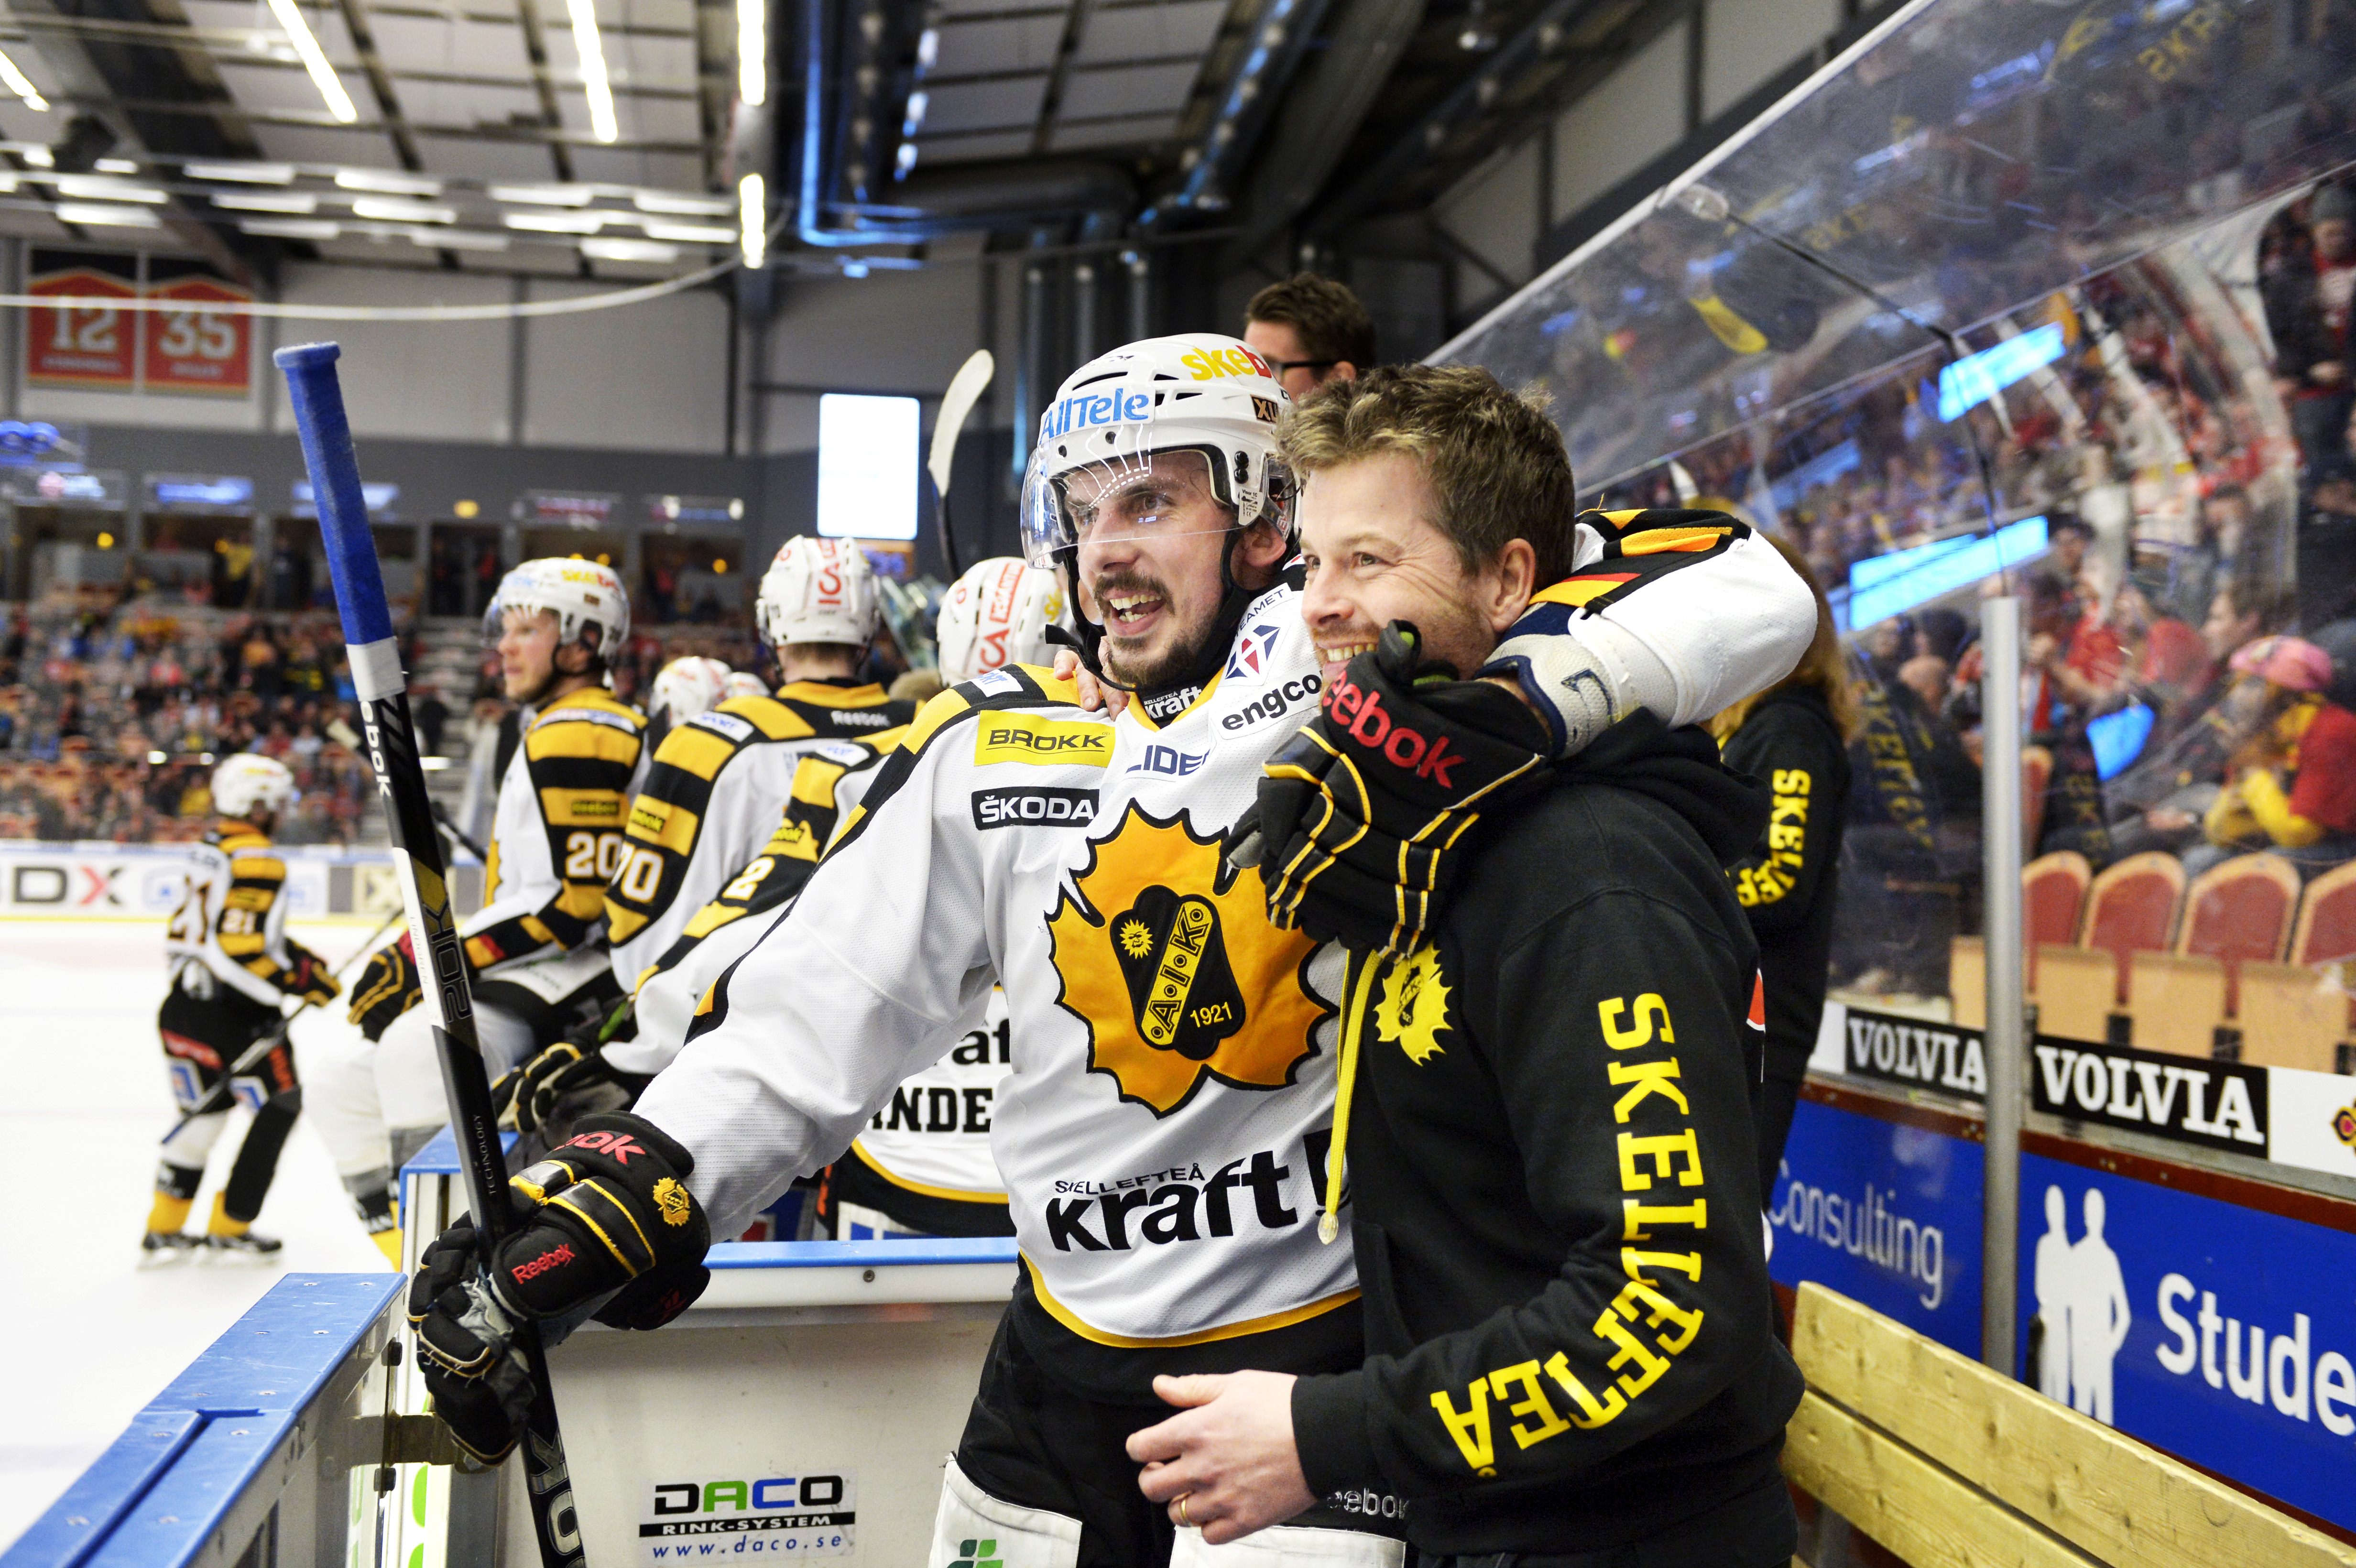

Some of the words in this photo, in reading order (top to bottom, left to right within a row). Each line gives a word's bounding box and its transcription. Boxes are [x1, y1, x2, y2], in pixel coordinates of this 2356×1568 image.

[52, 300, 118, 352] 12
[158, 303, 236, 359] 35
[1039, 388, 1148, 446] AllTele
[988, 729, 1106, 751] BROKK
[980, 795, 1095, 823] ŠKODA
[566, 831, 623, 879] 20
[1190, 1002, 1233, 1028] 1921
[1848, 1016, 1987, 1094] VOLVIA
[2035, 1045, 2265, 1145] VOLVIA
[473, 1114, 496, 1195] TECHNOLOGY
[1430, 992, 1708, 1477] SKELLEFTEÅ
[512, 1243, 576, 1285] Reebok
[2156, 1273, 2356, 1437] Stude
[654, 1475, 843, 1515] DACO
[653, 1535, 841, 1558] www.daco.se
[663, 1515, 831, 1536] RINK-SYSTEM
